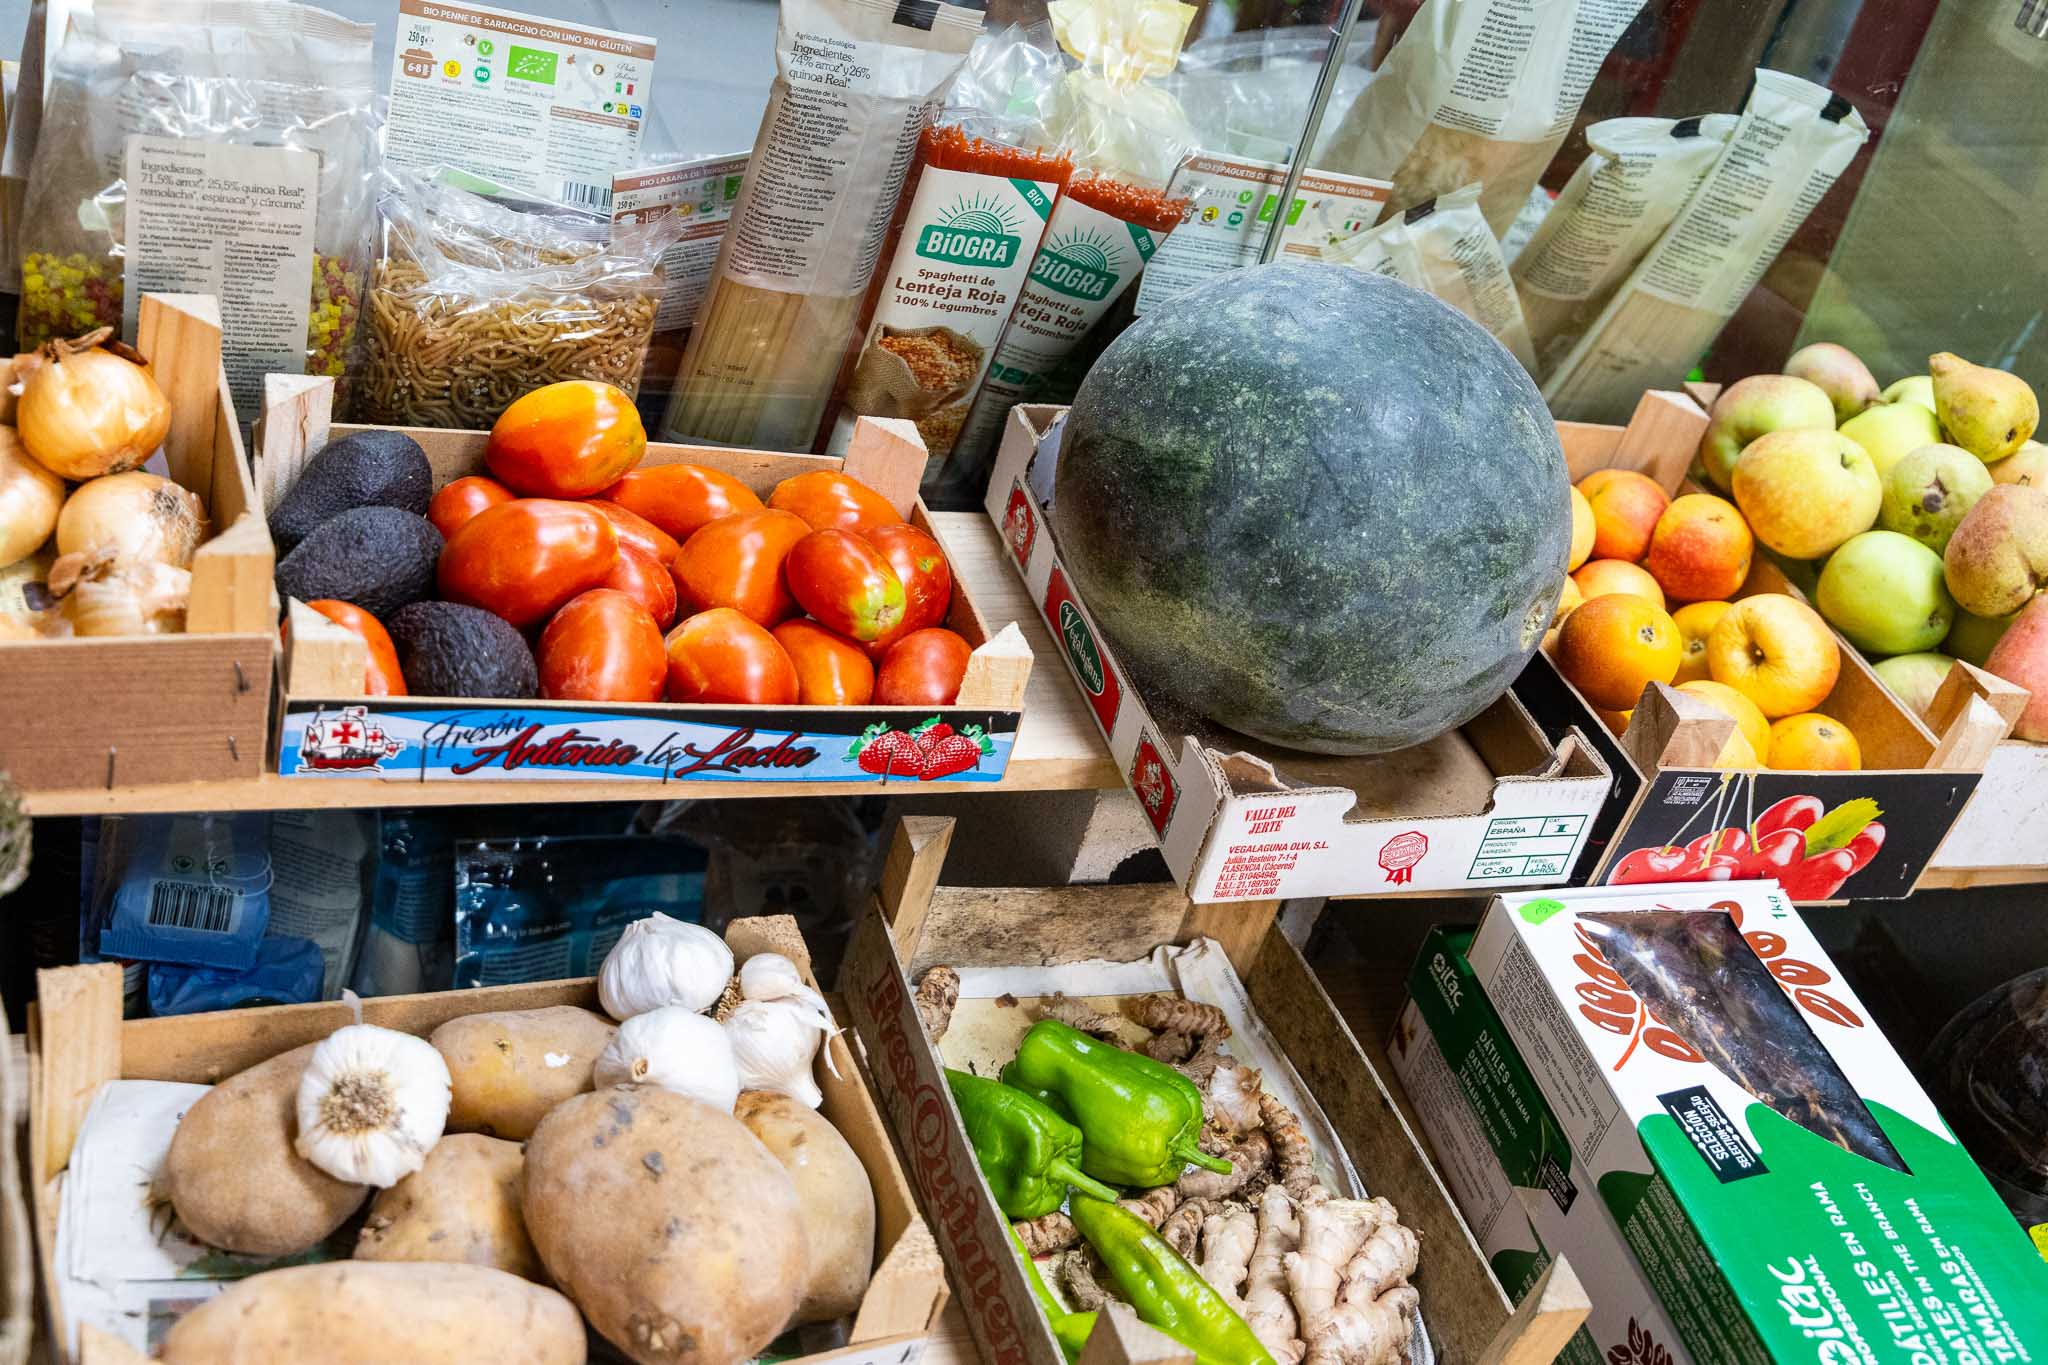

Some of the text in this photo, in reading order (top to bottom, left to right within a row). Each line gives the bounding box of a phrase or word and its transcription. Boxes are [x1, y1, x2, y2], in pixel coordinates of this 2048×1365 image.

[408, 31, 419, 42] 250
[423, 7, 633, 54] BIO PENNE DE SARRACENO CON LINO SIN GLUTEN
[793, 41, 854, 63] Ingredientes:
[408, 63, 421, 71] 6-8
[476, 70, 488, 78] BIO
[791, 53, 814, 68] 74%
[849, 65, 870, 79] 26%
[789, 69, 823, 83] quinoa
[804, 126, 820, 134] pasta
[141, 160, 204, 175] Ingredientes:
[141, 172, 175, 186] 71,5%
[208, 179, 240, 192] 25,5%
[241, 183, 276, 195] quinoa
[640, 179, 654, 187] BIO
[656, 172, 688, 186] LASAÑA
[1334, 185, 1347, 193] SIN
[617, 201, 627, 210] 250
[1026, 188, 1043, 207] BIO
[1136, 235, 1150, 252] BIO
[917, 268, 996, 287] Spaghetti de
[896, 277, 1007, 305] Lenteja Roja
[895, 295, 998, 317] 100% Legumbres
[1022, 290, 1084, 317] paghetti de
[1055, 311, 1088, 331] Roja
[423, 709, 528, 760] Fresón
[451, 724, 645, 776] Antonio
[673, 727, 821, 779] Lacha
[1244, 805, 1297, 822] VALLE DEL
[1248, 820, 1285, 835] JERTE
[1490, 826, 1527, 835] ESPAÑA
[1554, 824, 1569, 833] I
[1229, 840, 1329, 854] VEGALAGUNA OLVI, S.L.
[1221, 861, 1295, 873] PLASENCIA (Cáceres)
[1278, 853, 1298, 862] 7-1-A
[1482, 866, 1513, 875] C-30
[1234, 889, 1248, 897] 927
[1479, 1029, 1530, 1124] DÁTILES EN RAMA
[1468, 1049, 1489, 1084] DATES
[1500, 1106, 1518, 1139] BRANCH
[1684, 1110, 1729, 1160] SELECCIÓN
[1690, 1096, 1751, 1168] SELECTION-SELEÇÃO
[1809, 1181, 1848, 1227] RAMA
[1853, 1183, 1899, 1240] BRANCH
[1840, 1232, 1866, 1257] EN
[1892, 1244, 1920, 1273] THE
[1903, 1198, 2016, 1364] TÂMARAS EM RAMA
[1914, 1276, 1934, 1294] IN
[1804, 1254, 1880, 1365] ROFESSIONAL
[1884, 1271, 1929, 1331] DESECADA
